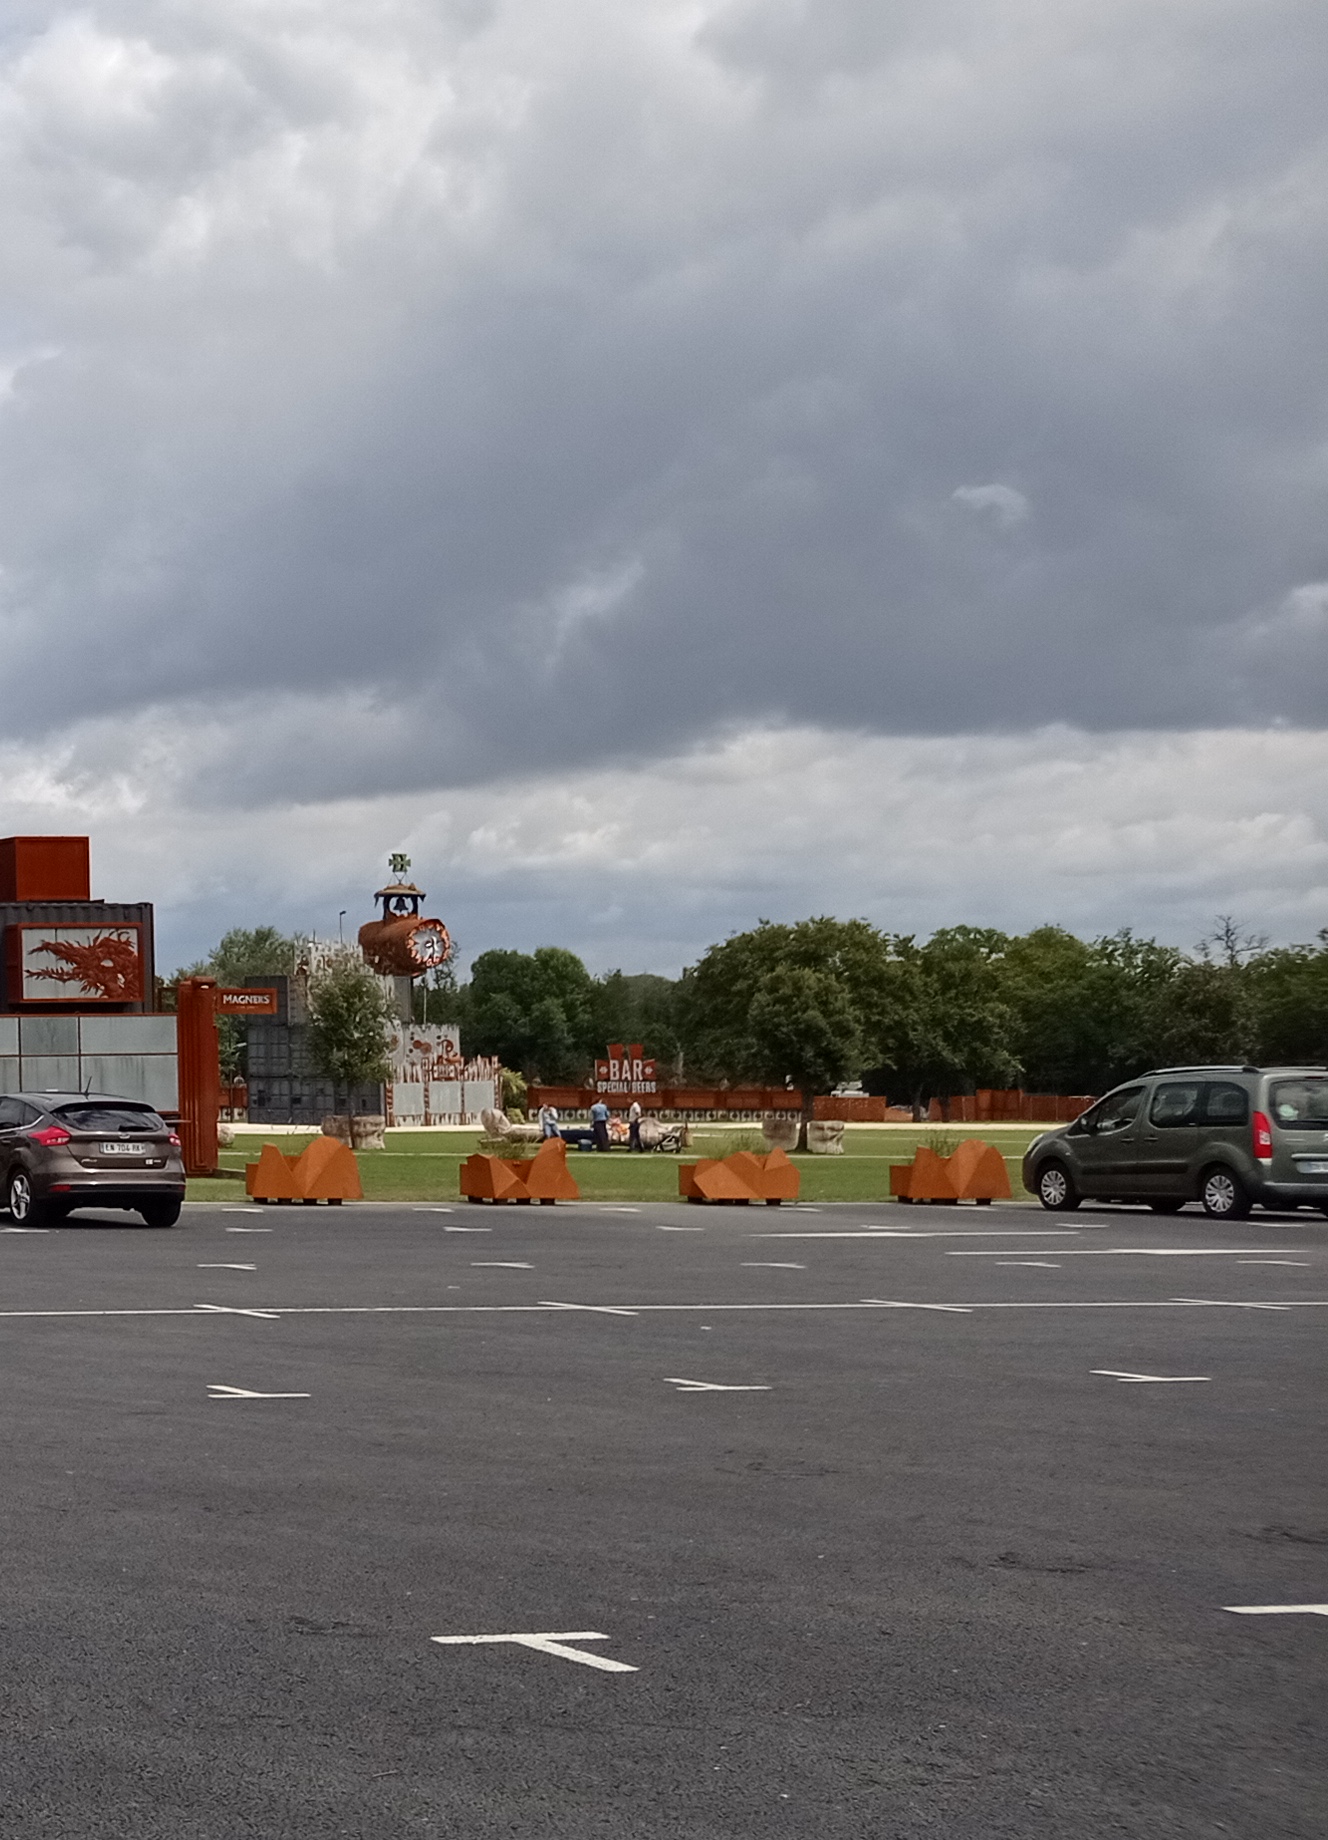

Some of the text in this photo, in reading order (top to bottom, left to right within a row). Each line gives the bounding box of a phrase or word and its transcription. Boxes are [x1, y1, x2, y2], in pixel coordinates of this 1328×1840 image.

[222, 994, 271, 1005] MAGNERS
[609, 1059, 643, 1080] BAR
[596, 1081, 629, 1093] SPECIAL
